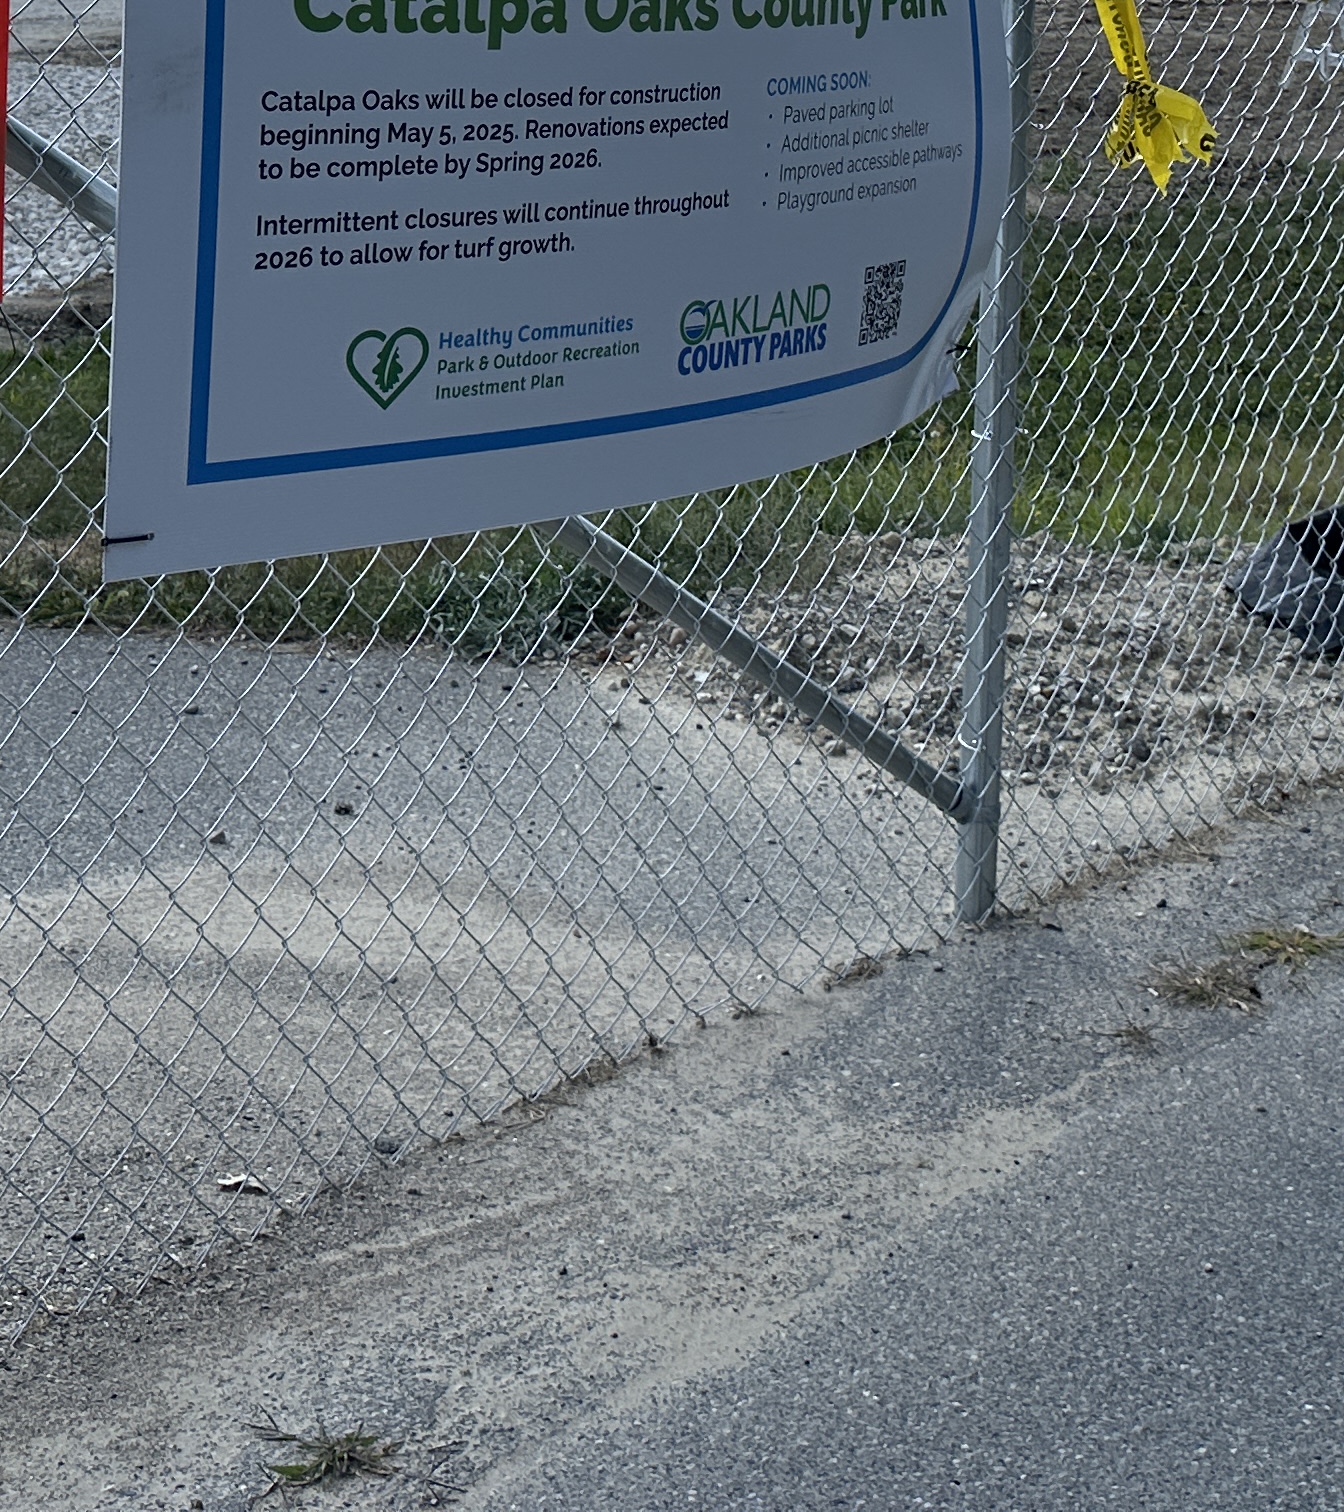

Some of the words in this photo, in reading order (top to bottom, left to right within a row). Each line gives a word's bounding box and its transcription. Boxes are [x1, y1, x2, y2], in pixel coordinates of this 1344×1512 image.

[261, 90, 355, 116] Catalpa
[362, 89, 419, 110] Oaks
[425, 88, 465, 109] will
[471, 88, 498, 108] be
[504, 87, 572, 108] closed
[579, 86, 606, 106] for
[610, 82, 720, 104] construction
[767, 73, 827, 96] COMING
[830, 70, 871, 91] SOON:
[784, 103, 826, 124] Paved
[829, 100, 875, 124] parking
[879, 96, 894, 114] lot
[261, 123, 380, 151] beginning
[387, 123, 434, 148] May
[439, 126, 456, 145] 5,
[463, 124, 518, 144] 2025.
[526, 116, 644, 139] Renovations
[650, 110, 728, 138] expected
[781, 128, 849, 153] Additional
[853, 124, 888, 150] picnic
[892, 120, 929, 138] shelter
[259, 159, 282, 179] to
[290, 158, 320, 178] be
[327, 154, 438, 181] complete
[445, 153, 471, 179] by
[476, 151, 544, 177] Spring
[550, 148, 602, 169] 2026.
[779, 157, 844, 184] Improved
[847, 149, 910, 174] accessible
[913, 143, 962, 168] pathways
[778, 183, 854, 213] Playground
[858, 176, 916, 202] expansion
[257, 211, 398, 236] Intermittent
[405, 208, 497, 229] closures
[503, 202, 540, 224] will
[545, 199, 629, 221] continue
[635, 190, 729, 216] throughout
[254, 247, 313, 270] 2026
[320, 246, 343, 266] to
[350, 243, 413, 265] allow
[419, 240, 449, 261] for
[455, 236, 494, 258] turf
[498, 232, 574, 261] growth.
[680, 284, 830, 345] OAKLAND
[439, 328, 512, 350] Healthy
[518, 316, 633, 342] Communities
[678, 334, 767, 375] COUNTY
[769, 323, 827, 360] PARKS
[437, 359, 474, 374] Park
[479, 357, 488, 370] &
[494, 349, 558, 369] Outdoor
[563, 341, 640, 362] Recreation
[436, 378, 526, 400] Investment
[531, 373, 564, 388] Plan
